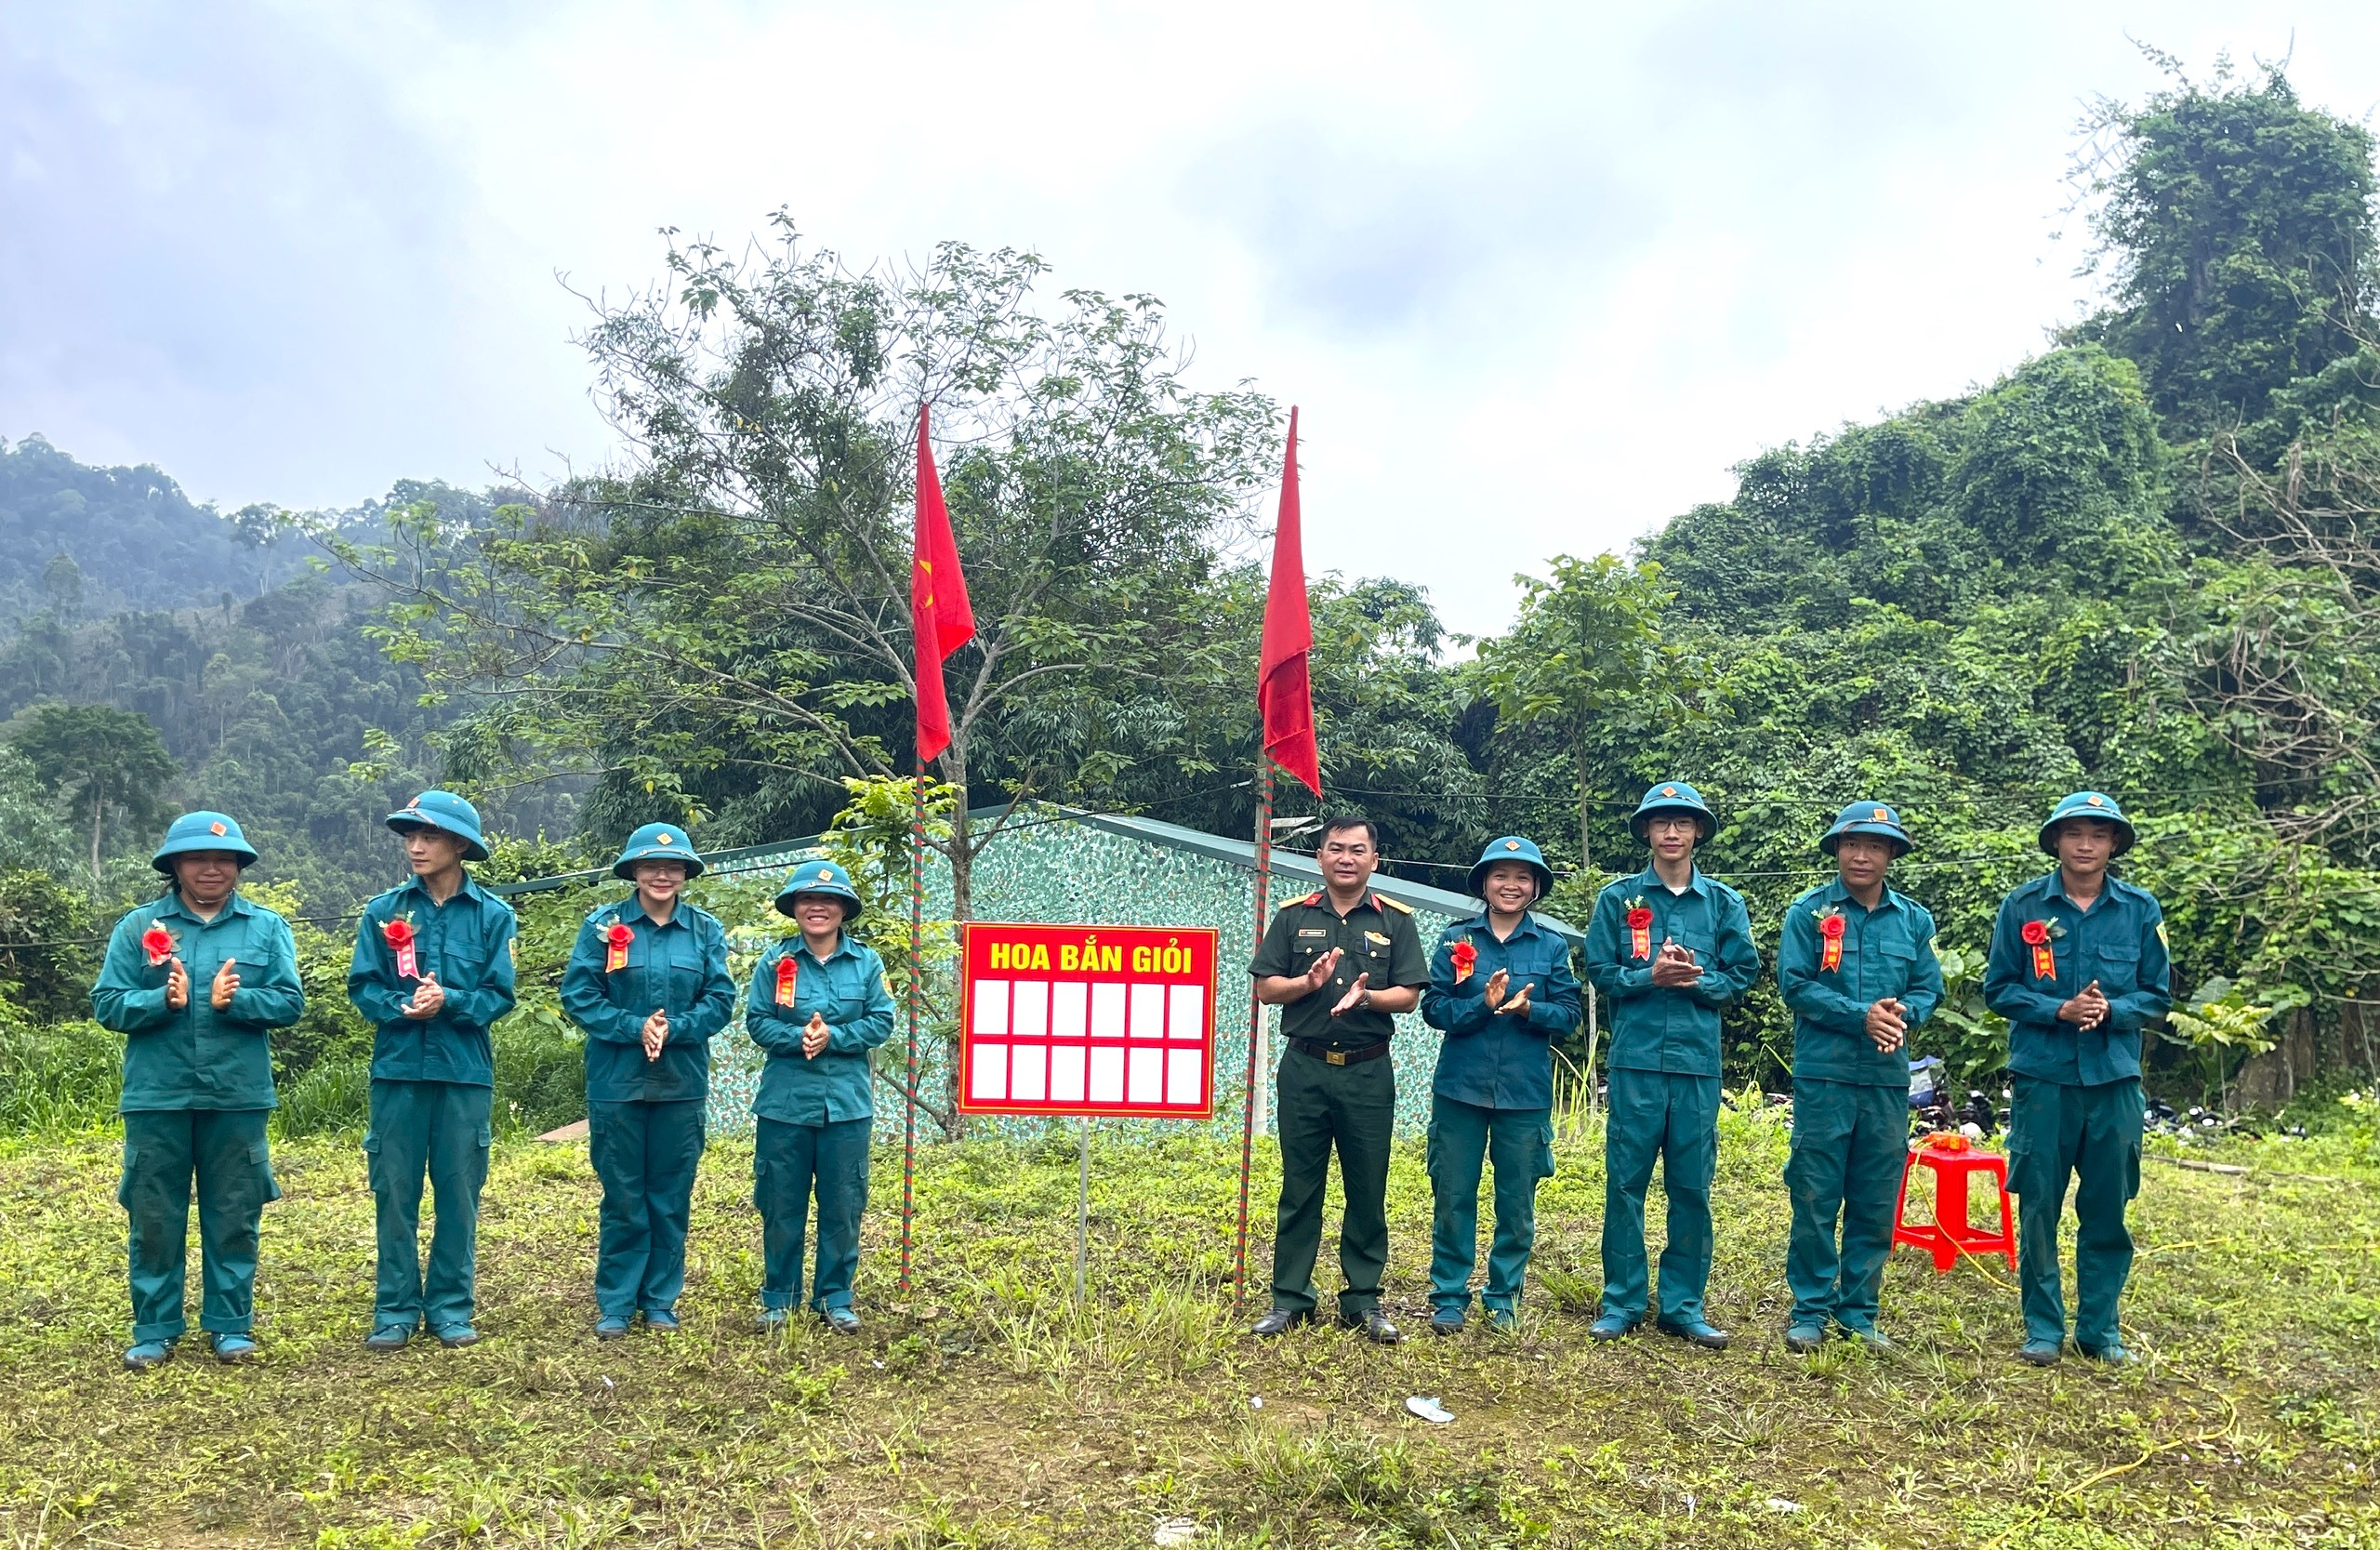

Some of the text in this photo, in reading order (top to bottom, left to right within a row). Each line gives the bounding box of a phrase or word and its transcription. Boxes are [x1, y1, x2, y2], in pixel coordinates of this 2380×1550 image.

[990, 934, 1192, 974] HOA BẮN GIỎI
